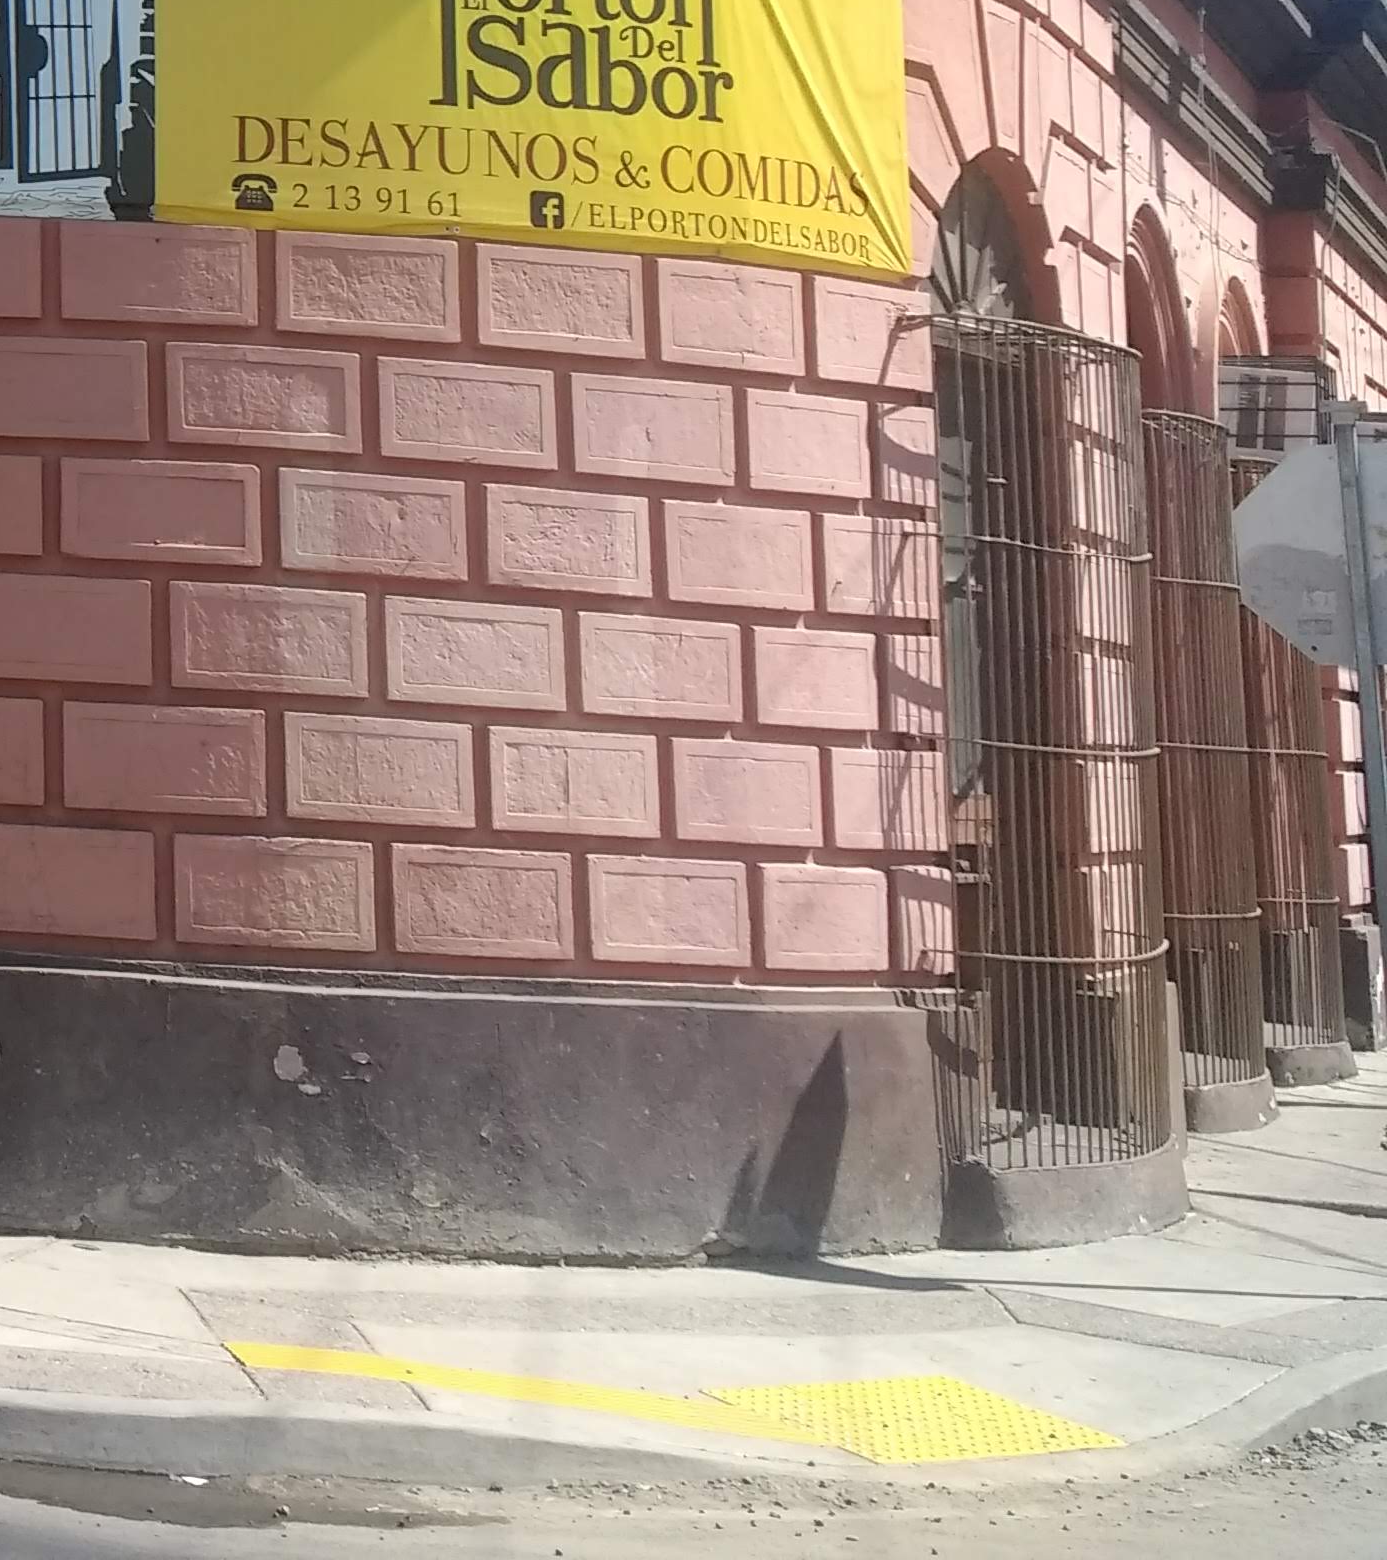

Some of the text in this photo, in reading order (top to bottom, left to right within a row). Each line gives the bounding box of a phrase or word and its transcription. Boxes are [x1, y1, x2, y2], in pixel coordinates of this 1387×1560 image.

[466, 14, 735, 123] Sabor
[619, 25, 687, 64] Del
[231, 115, 871, 219] DESAYUNOS & COMIDAS
[291, 183, 463, 218] 2 13 91 61
